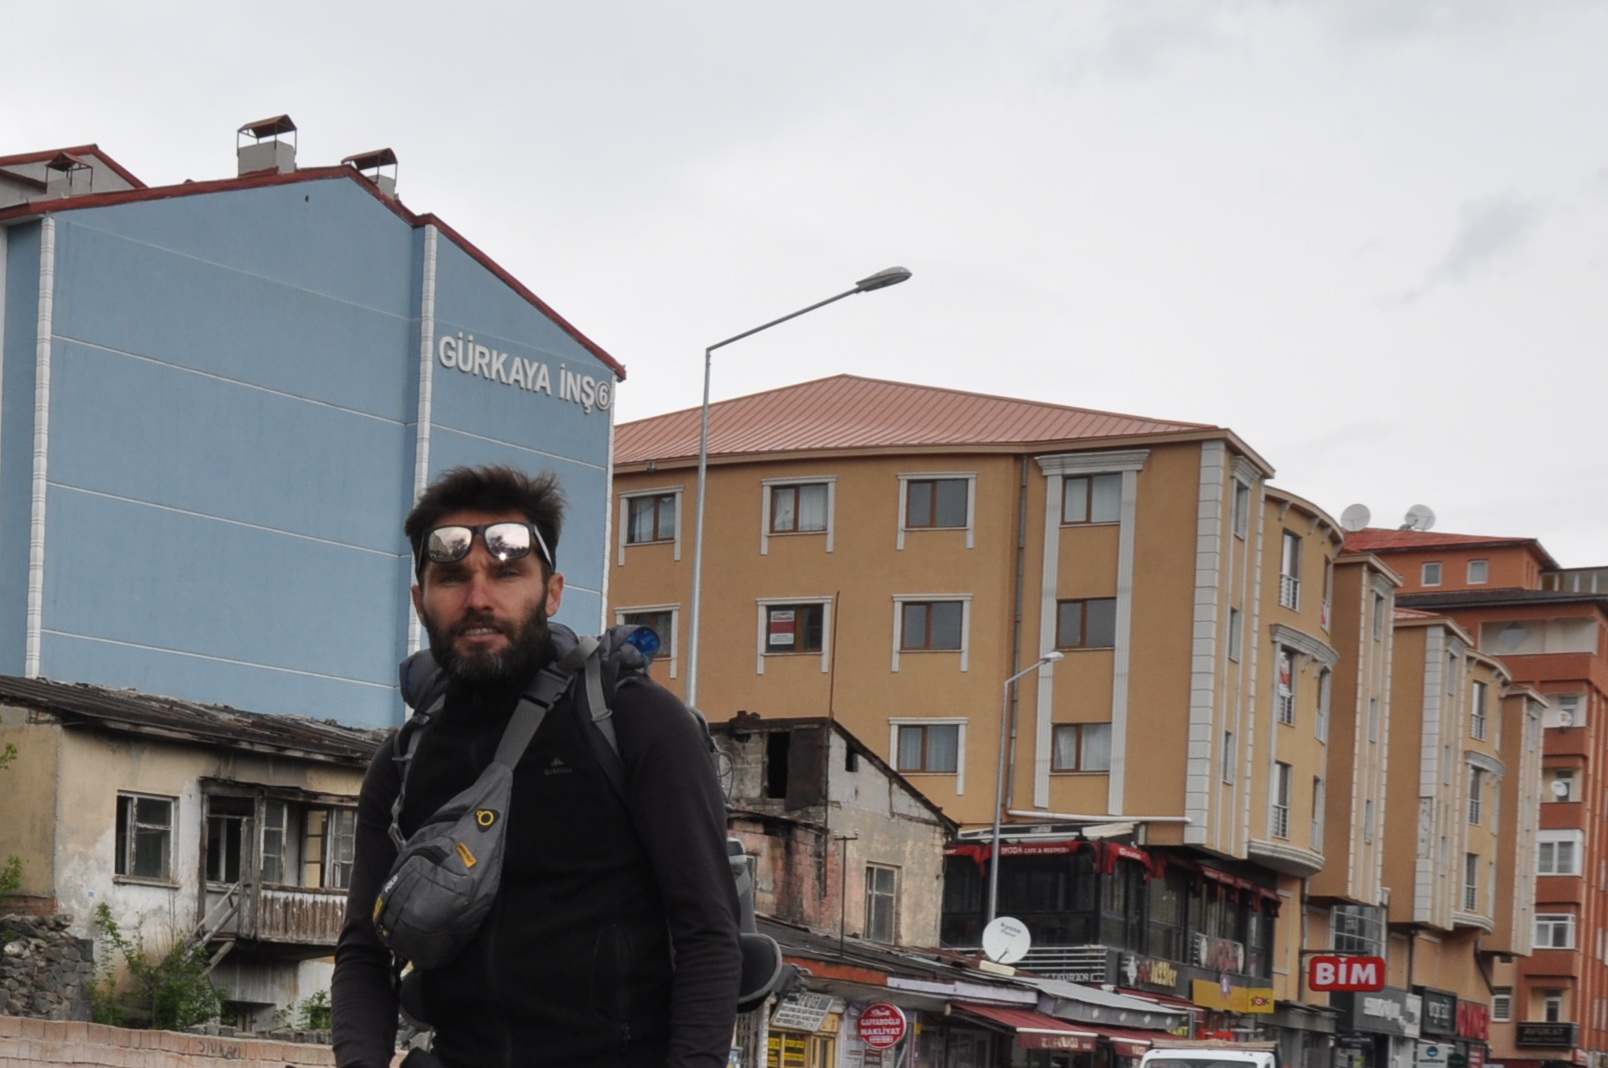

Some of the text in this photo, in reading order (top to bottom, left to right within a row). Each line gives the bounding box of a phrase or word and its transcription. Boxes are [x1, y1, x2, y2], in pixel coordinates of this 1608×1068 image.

[438, 331, 553, 397] GÜRKAYA
[1001, 846, 1023, 855] MODA
[1315, 957, 1377, 986] BİM
[861, 1026, 901, 1035] NAKLİYAT
